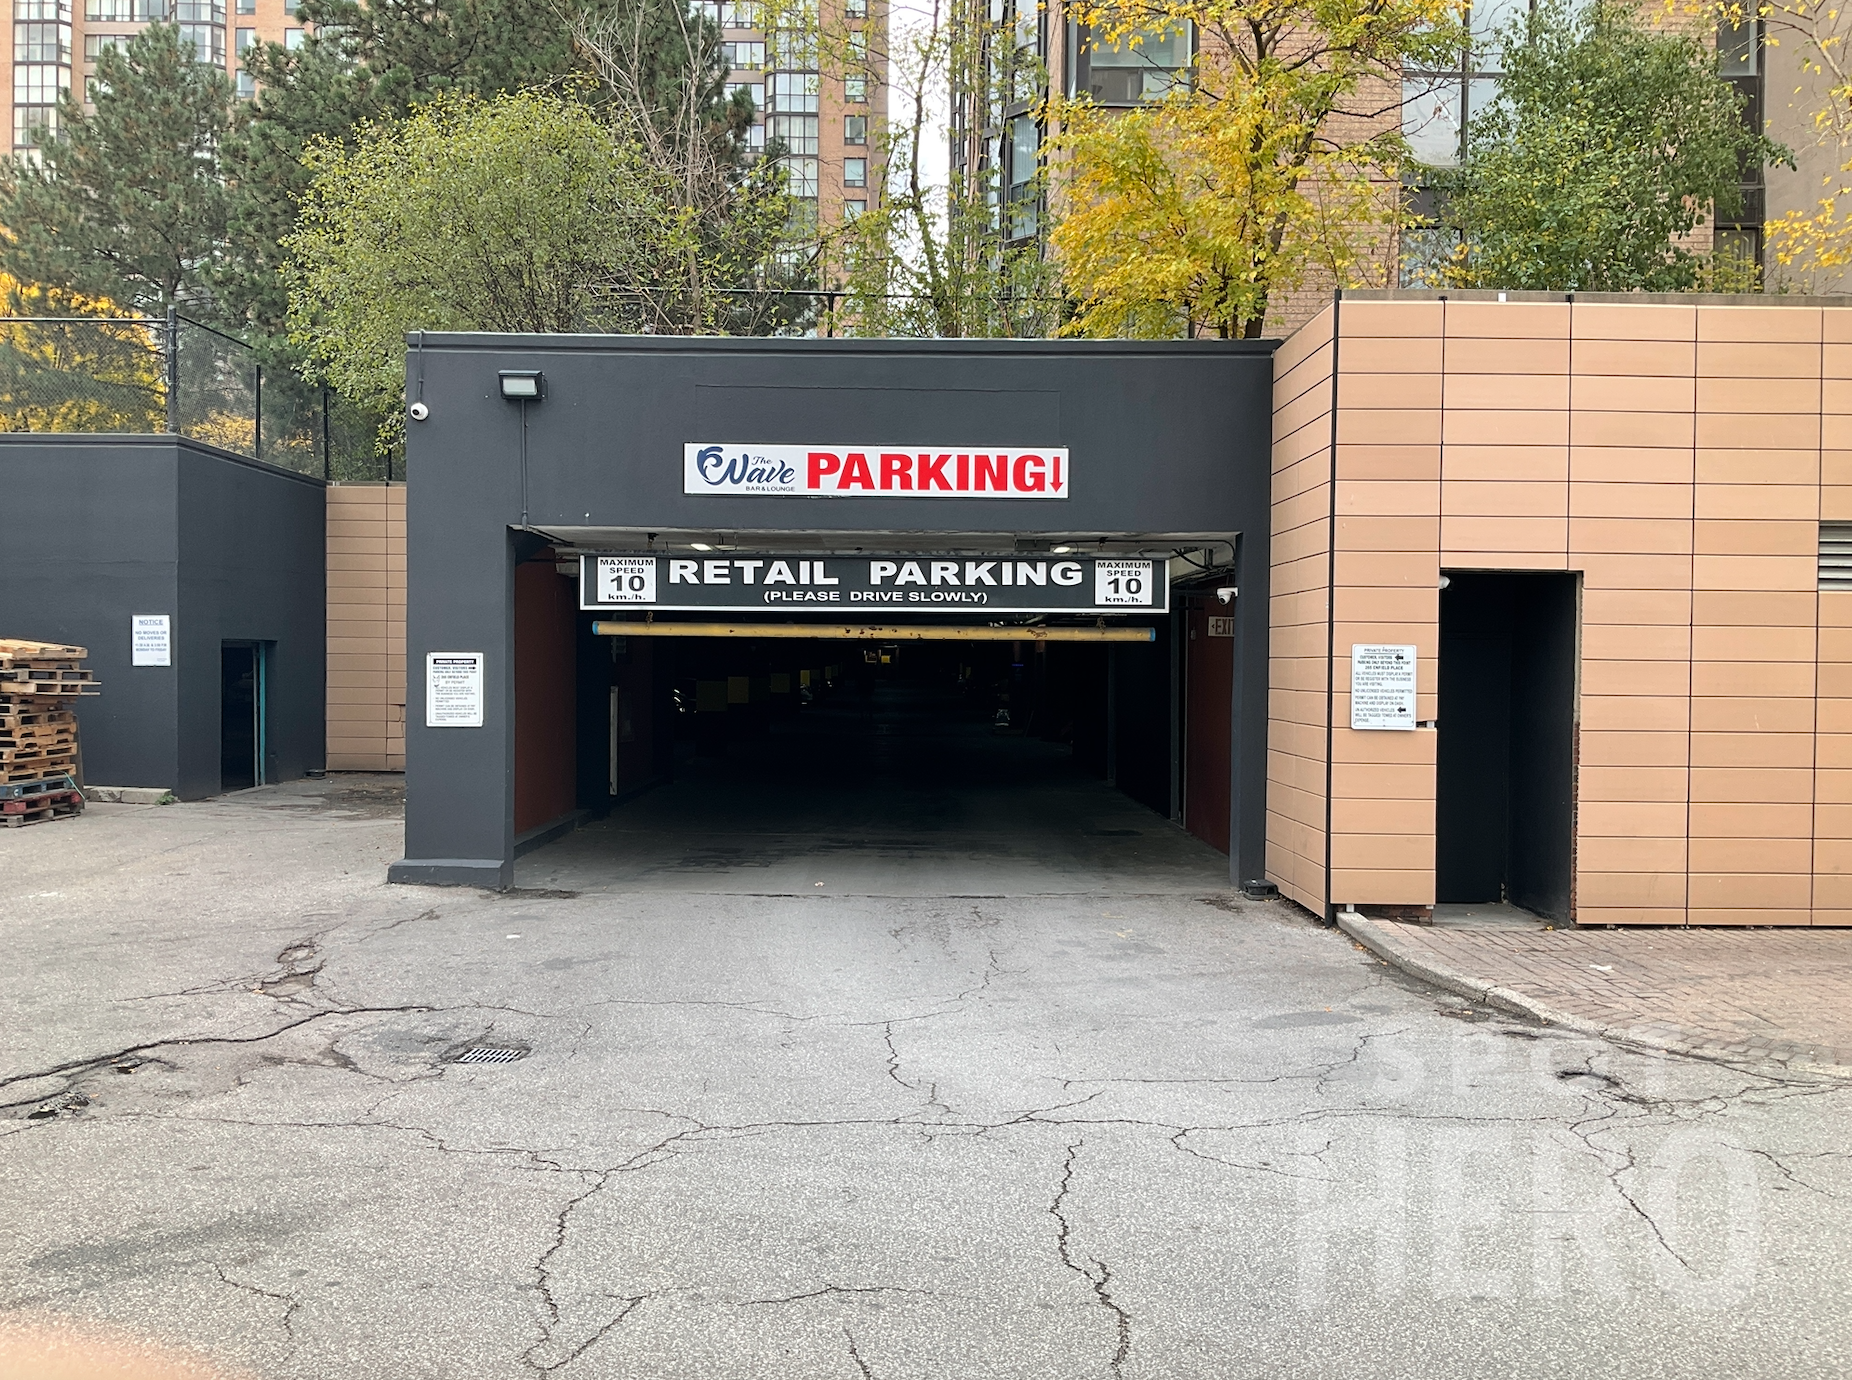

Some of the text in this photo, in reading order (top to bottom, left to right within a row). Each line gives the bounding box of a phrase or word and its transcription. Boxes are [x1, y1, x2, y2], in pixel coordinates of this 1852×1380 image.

[697, 446, 795, 486] Wave
[752, 456, 773, 465] The
[807, 452, 1046, 492] PARKING
[668, 559, 1083, 586] RETAIL PARKING
[1106, 569, 1141, 577] SPEED
[610, 575, 645, 592] 10
[1107, 578, 1142, 594] 10
[608, 593, 646, 601] km./h.
[763, 591, 988, 604] (PLEASE DRIVE SLOWLY)
